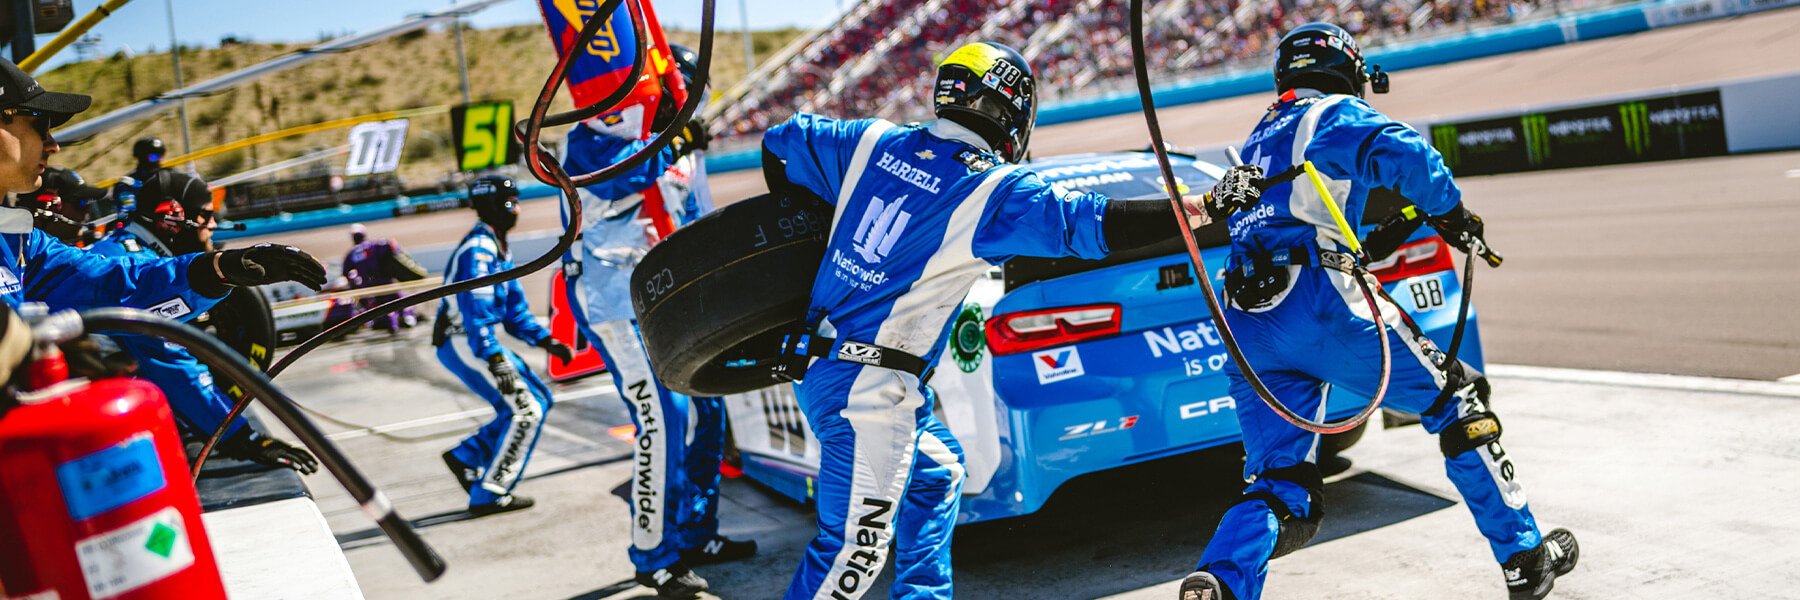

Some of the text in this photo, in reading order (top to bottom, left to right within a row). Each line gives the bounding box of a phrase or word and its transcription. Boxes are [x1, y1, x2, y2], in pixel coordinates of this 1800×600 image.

[990, 58, 1022, 87] 88
[345, 119, 409, 176] 11
[460, 104, 512, 171] 51
[1410, 279, 1443, 309] 88
[1182, 357, 1203, 377] is
[628, 379, 658, 530] Nationwide
